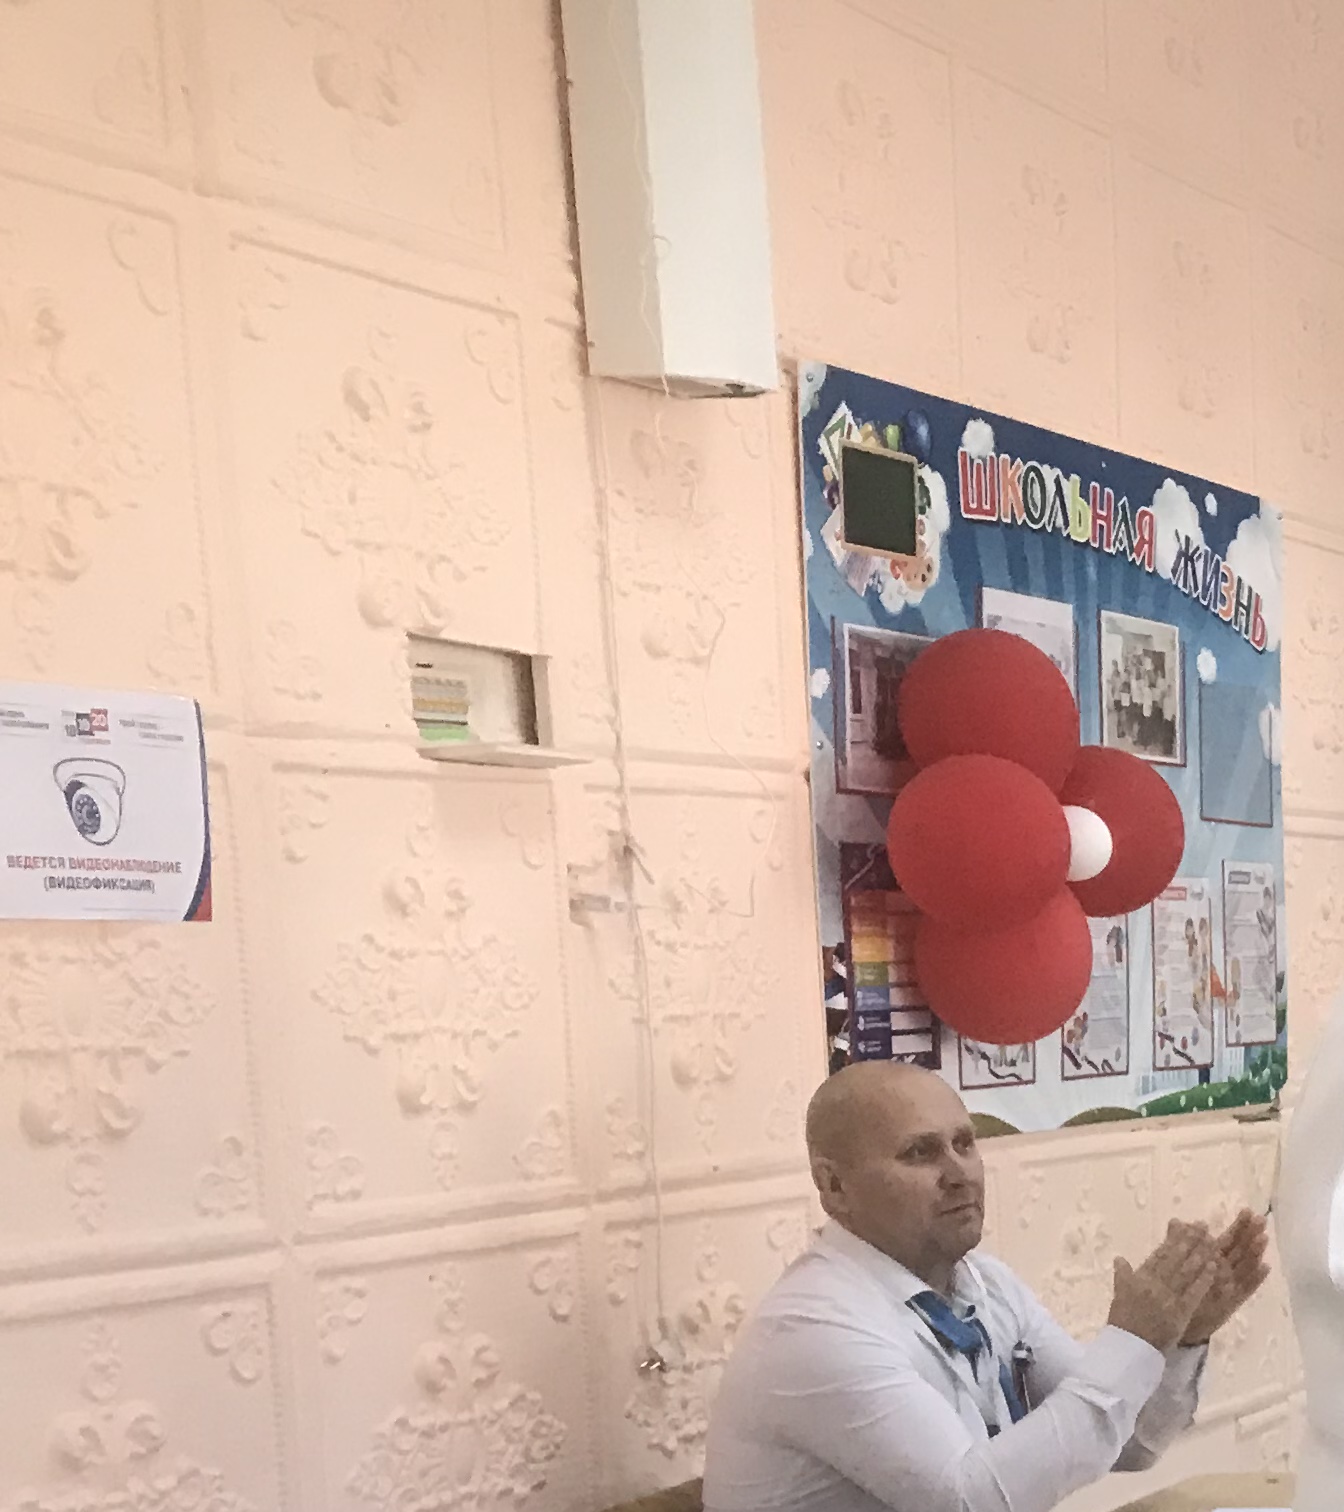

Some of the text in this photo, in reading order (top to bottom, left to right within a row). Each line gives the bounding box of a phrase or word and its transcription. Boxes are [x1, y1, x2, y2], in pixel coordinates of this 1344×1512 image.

[959, 446, 1267, 652] ШКОЛЬНАЯ ЖИЗНЬ
[6, 854, 182, 874] ВЕДЕТСЯ ВИДЕОНАБЛЮДЕНИЕ
[43, 875, 155, 894] (ВИДЕОФИКСАЦИЯ)
